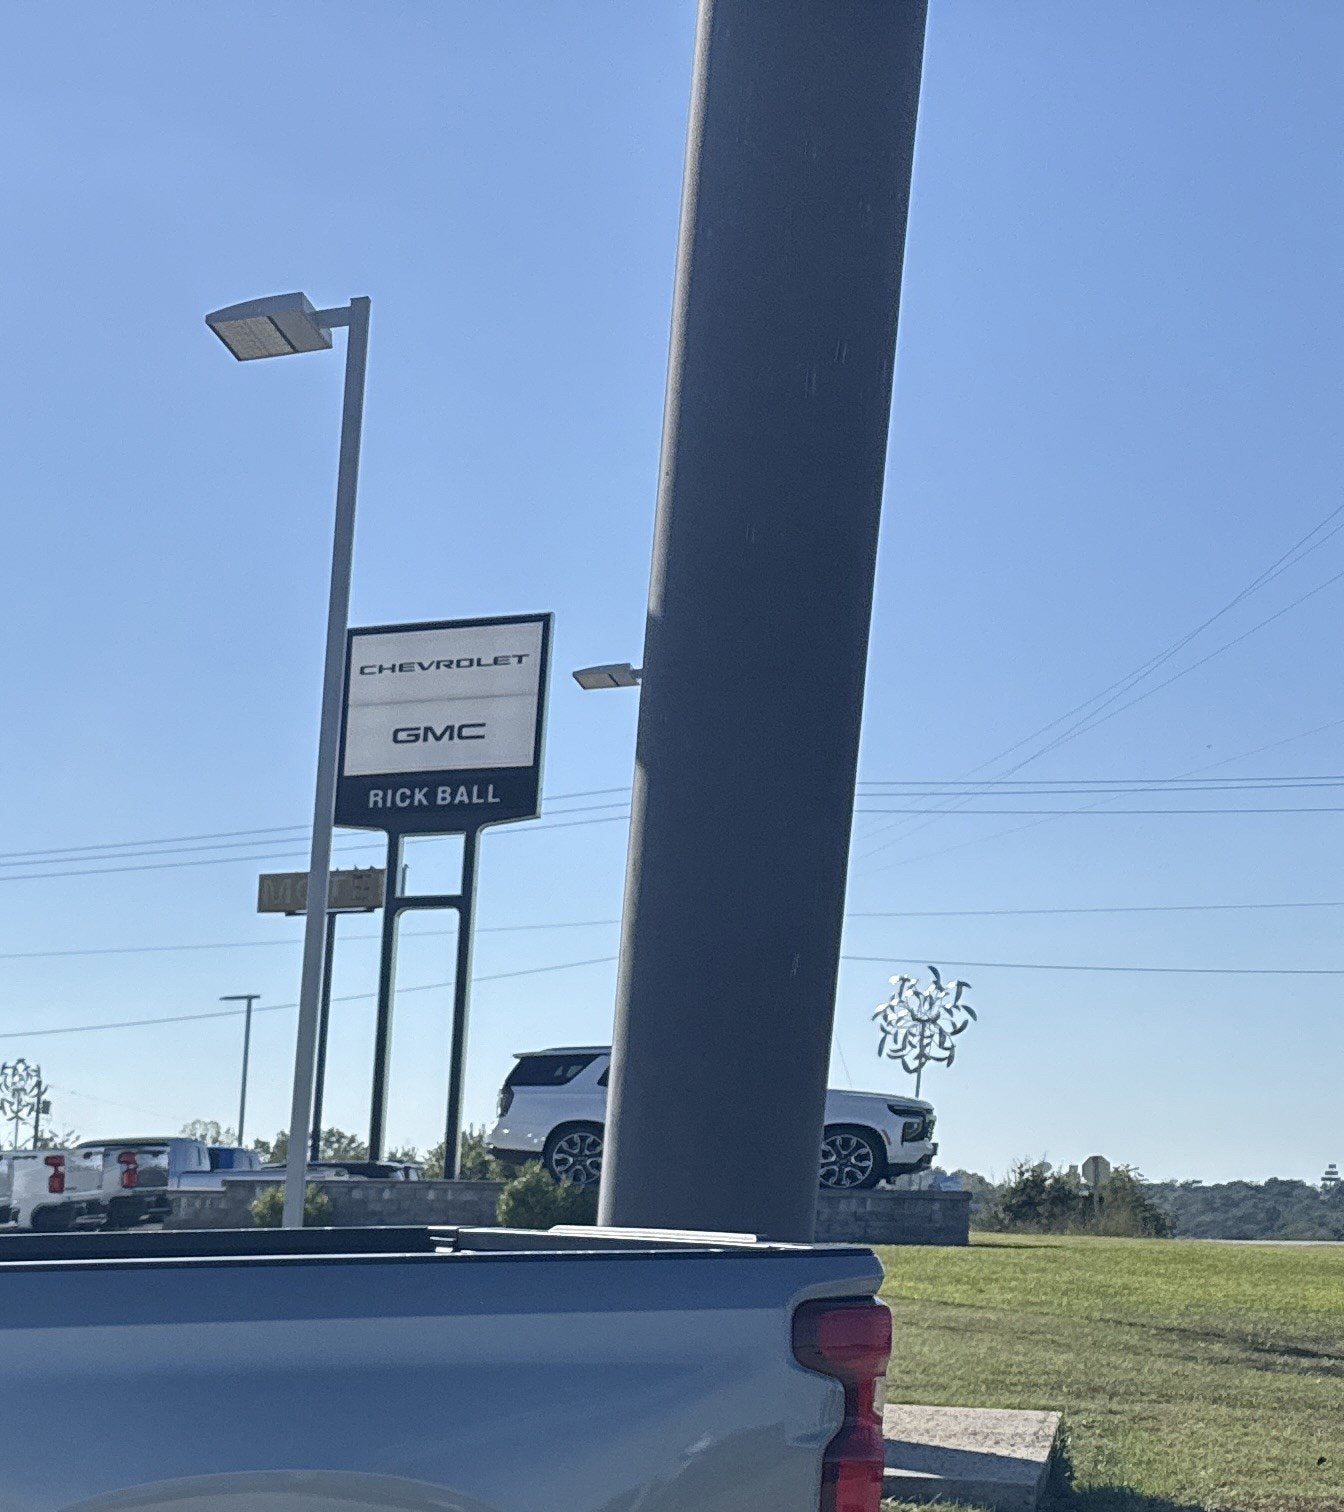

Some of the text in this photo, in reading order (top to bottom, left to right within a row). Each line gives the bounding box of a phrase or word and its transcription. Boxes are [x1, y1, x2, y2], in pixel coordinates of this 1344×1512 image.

[358, 653, 531, 677] CHEVROLET
[392, 722, 487, 745] GMC
[368, 784, 501, 809] RICK BALL
